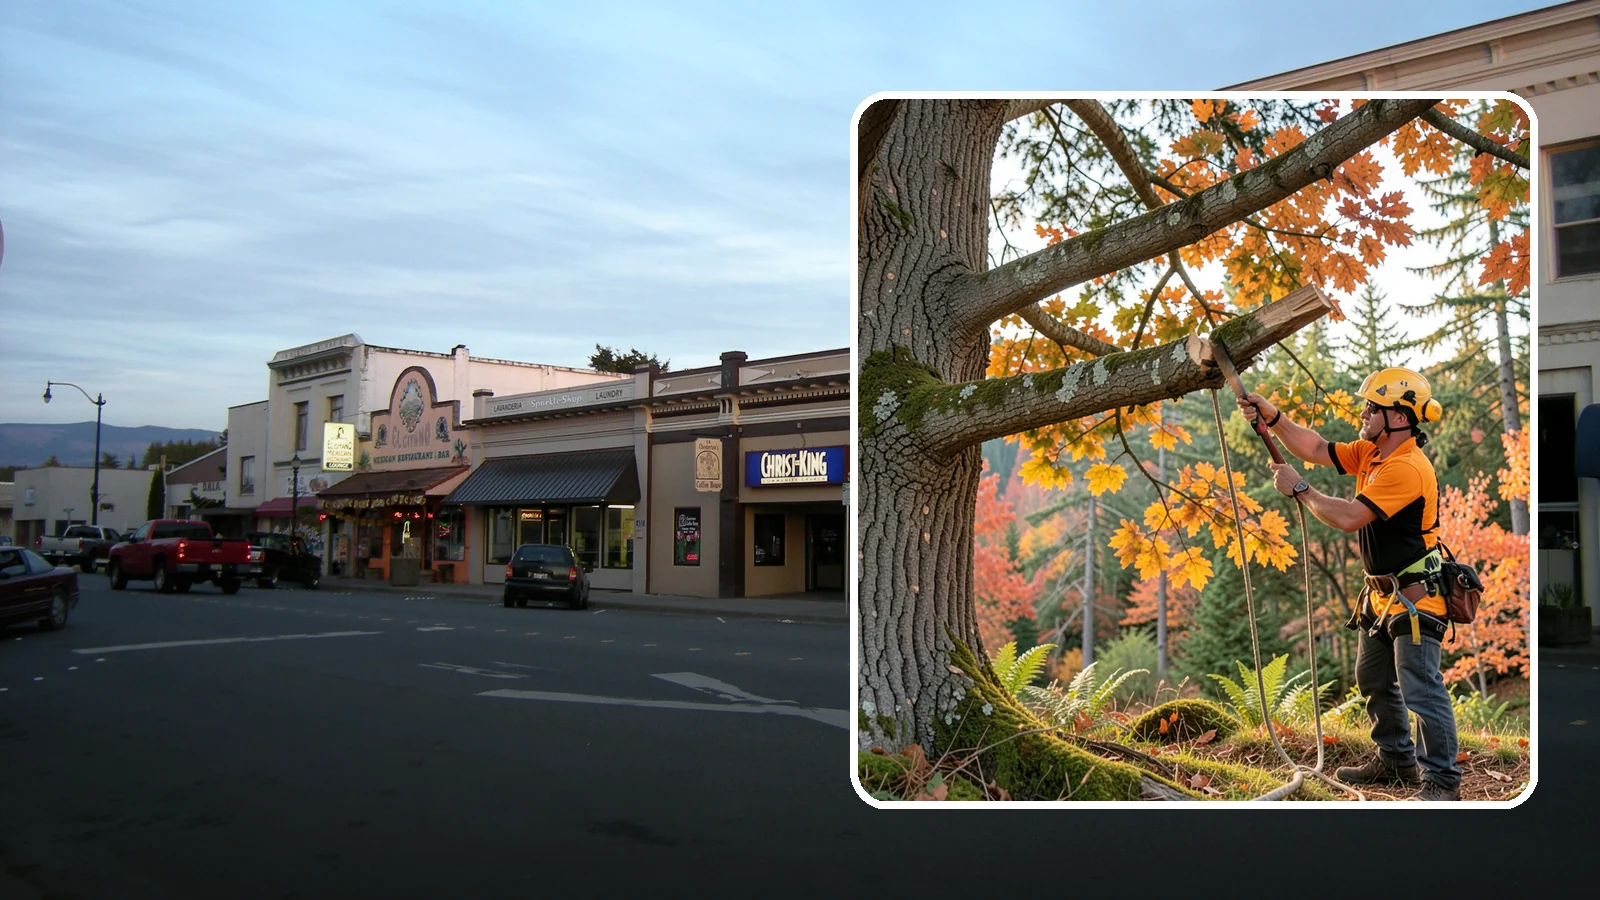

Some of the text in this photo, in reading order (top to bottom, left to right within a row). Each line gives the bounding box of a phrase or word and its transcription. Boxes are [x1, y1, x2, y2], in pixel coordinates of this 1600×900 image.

[530, 394, 583, 409] Sparkle Shop
[595, 389, 623, 400] LAUNDRY
[493, 402, 523, 413] LAVANDERIA
[373, 454, 396, 465] MEXICAN
[397, 451, 433, 463] RESTAURANT
[438, 450, 450, 460] BAR
[761, 450, 827, 478] CHRIST KING
